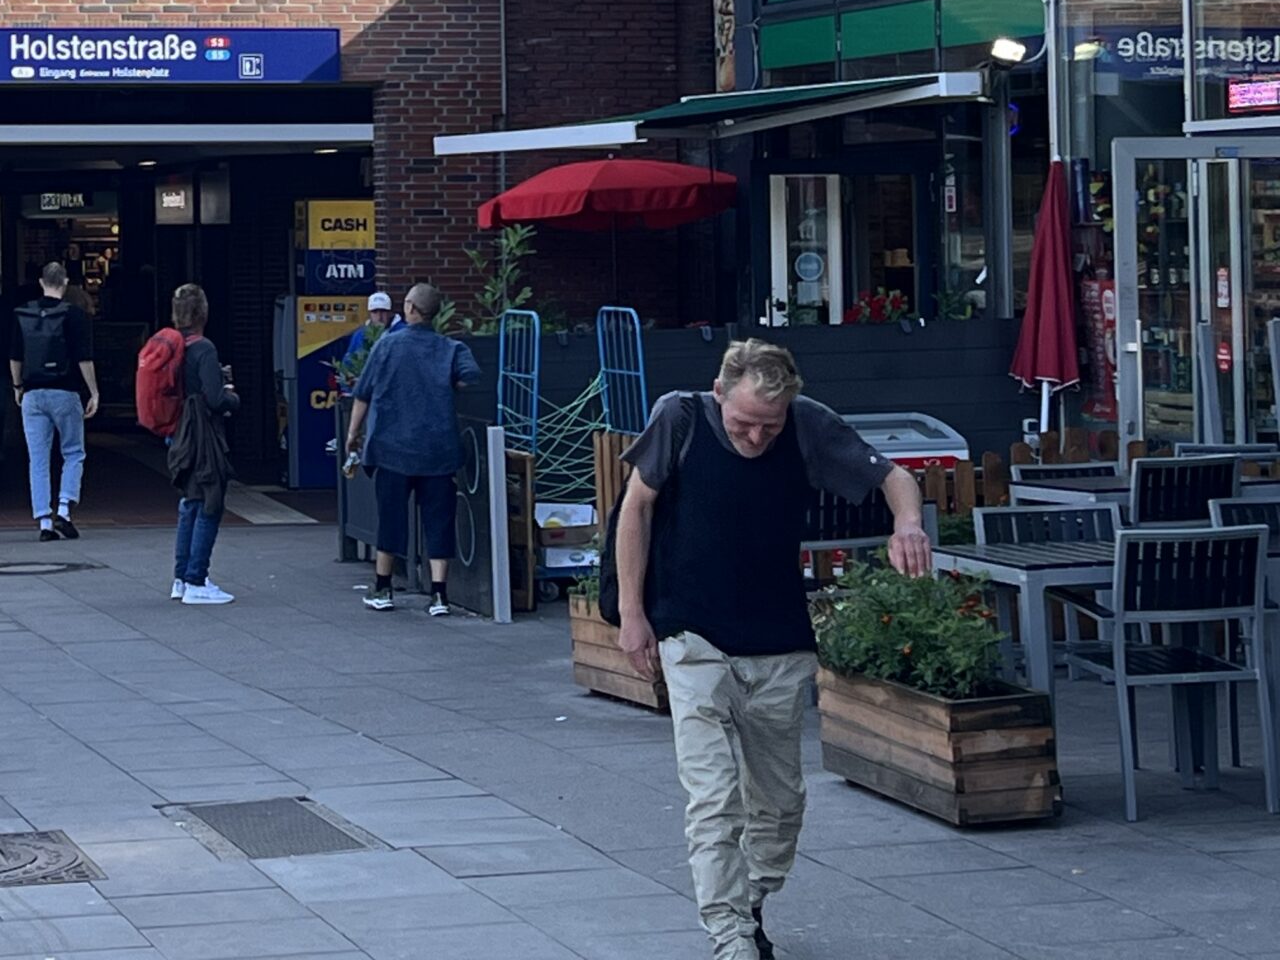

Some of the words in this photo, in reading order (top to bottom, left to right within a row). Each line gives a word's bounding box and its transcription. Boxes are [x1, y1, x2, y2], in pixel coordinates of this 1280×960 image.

[10, 33, 197, 61] Holstenstraße
[39, 67, 76, 79] Eingang
[112, 67, 170, 78] Holstenplatz
[321, 217, 368, 232] CASH
[325, 263, 365, 279] ATM
